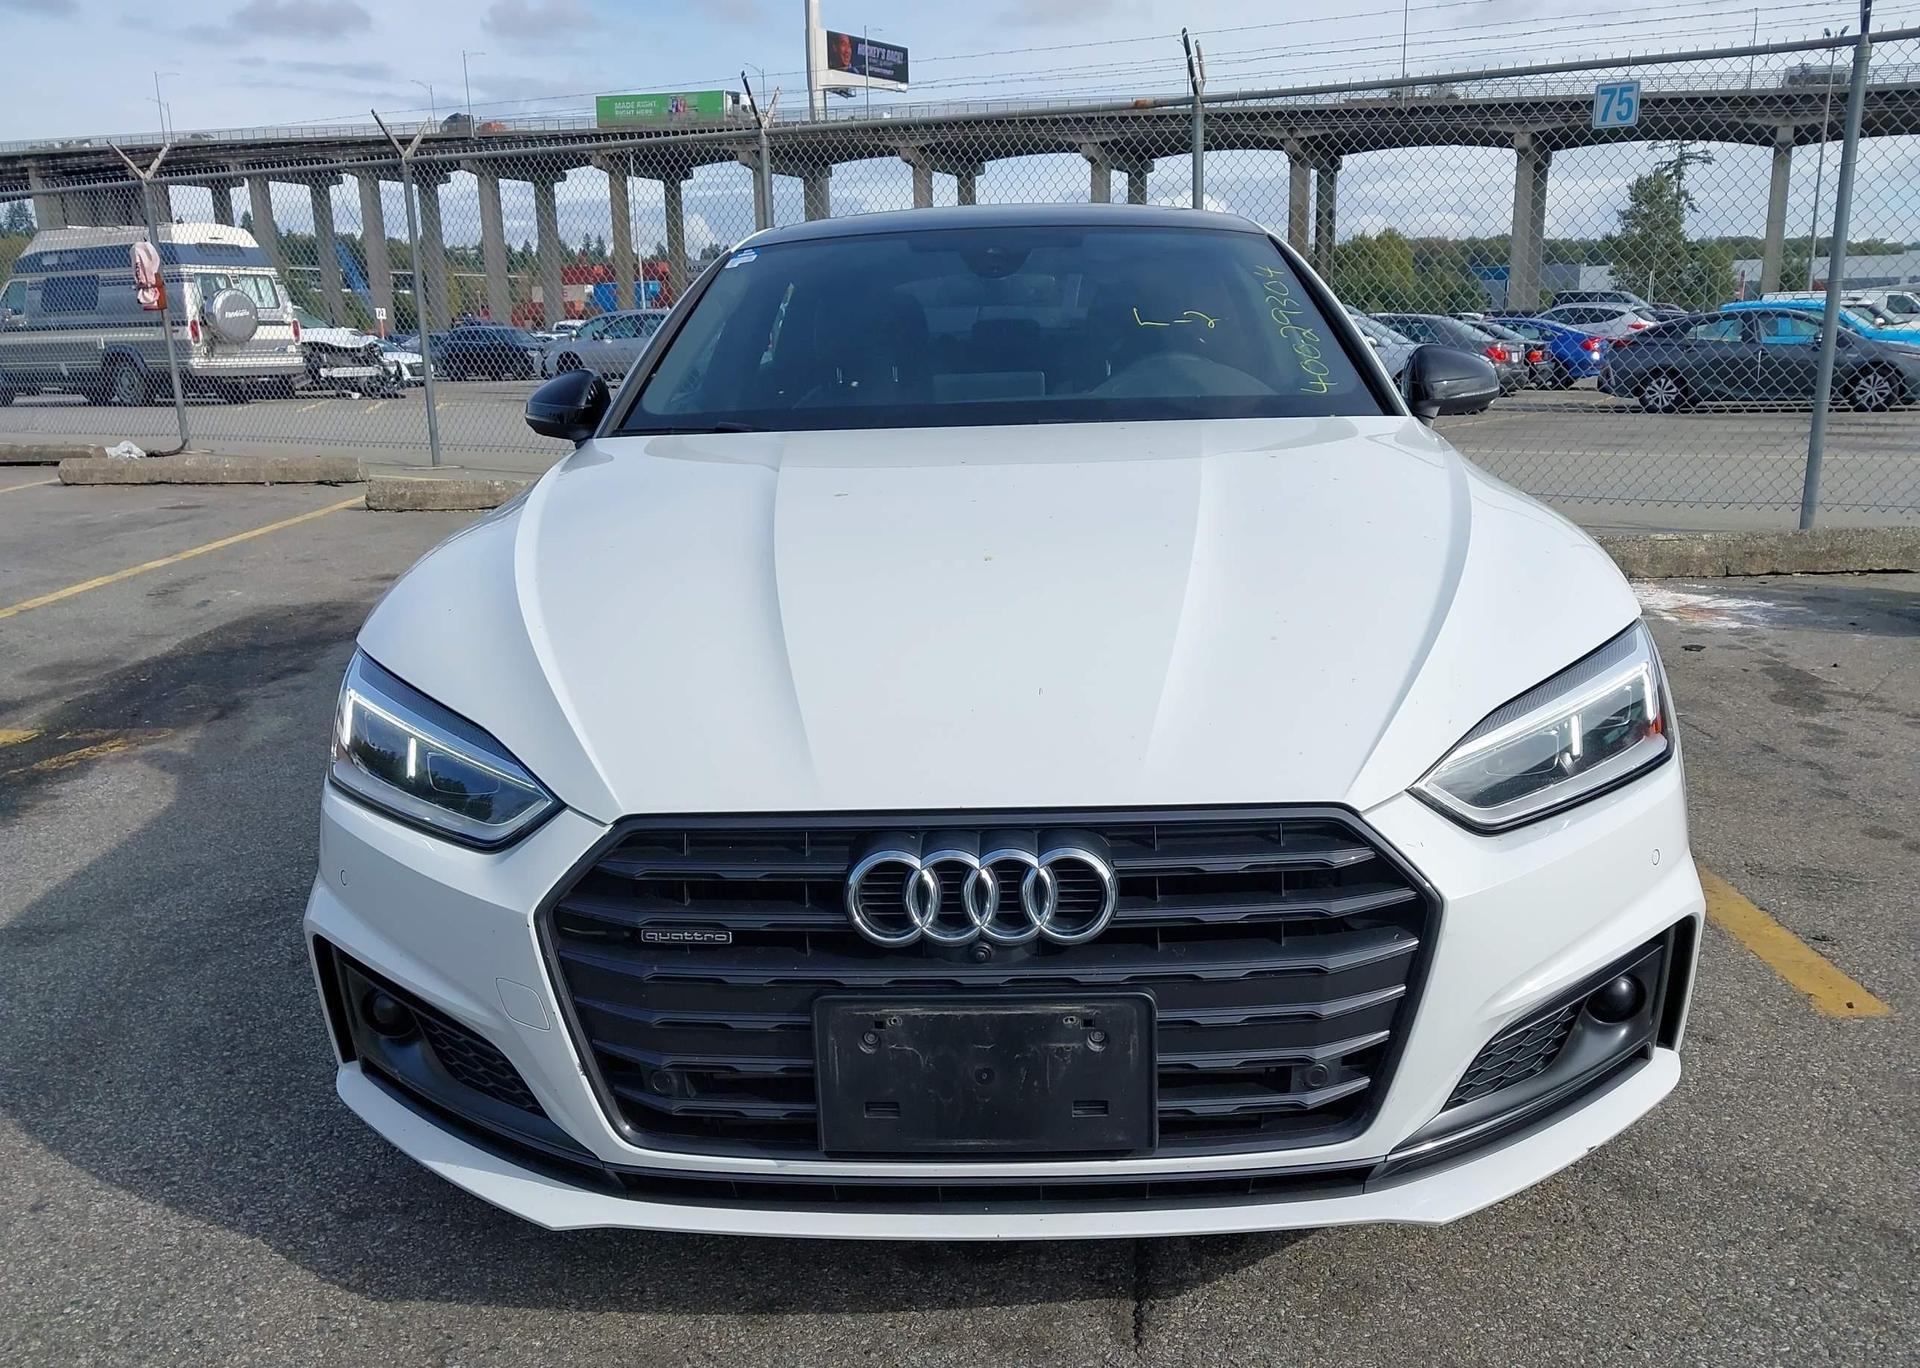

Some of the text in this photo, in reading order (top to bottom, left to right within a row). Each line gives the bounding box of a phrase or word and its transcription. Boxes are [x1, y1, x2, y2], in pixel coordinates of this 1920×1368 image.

[636, 100, 656, 108] RIGHT
[1600, 86, 1634, 122] 75
[644, 931, 729, 942] quattro
